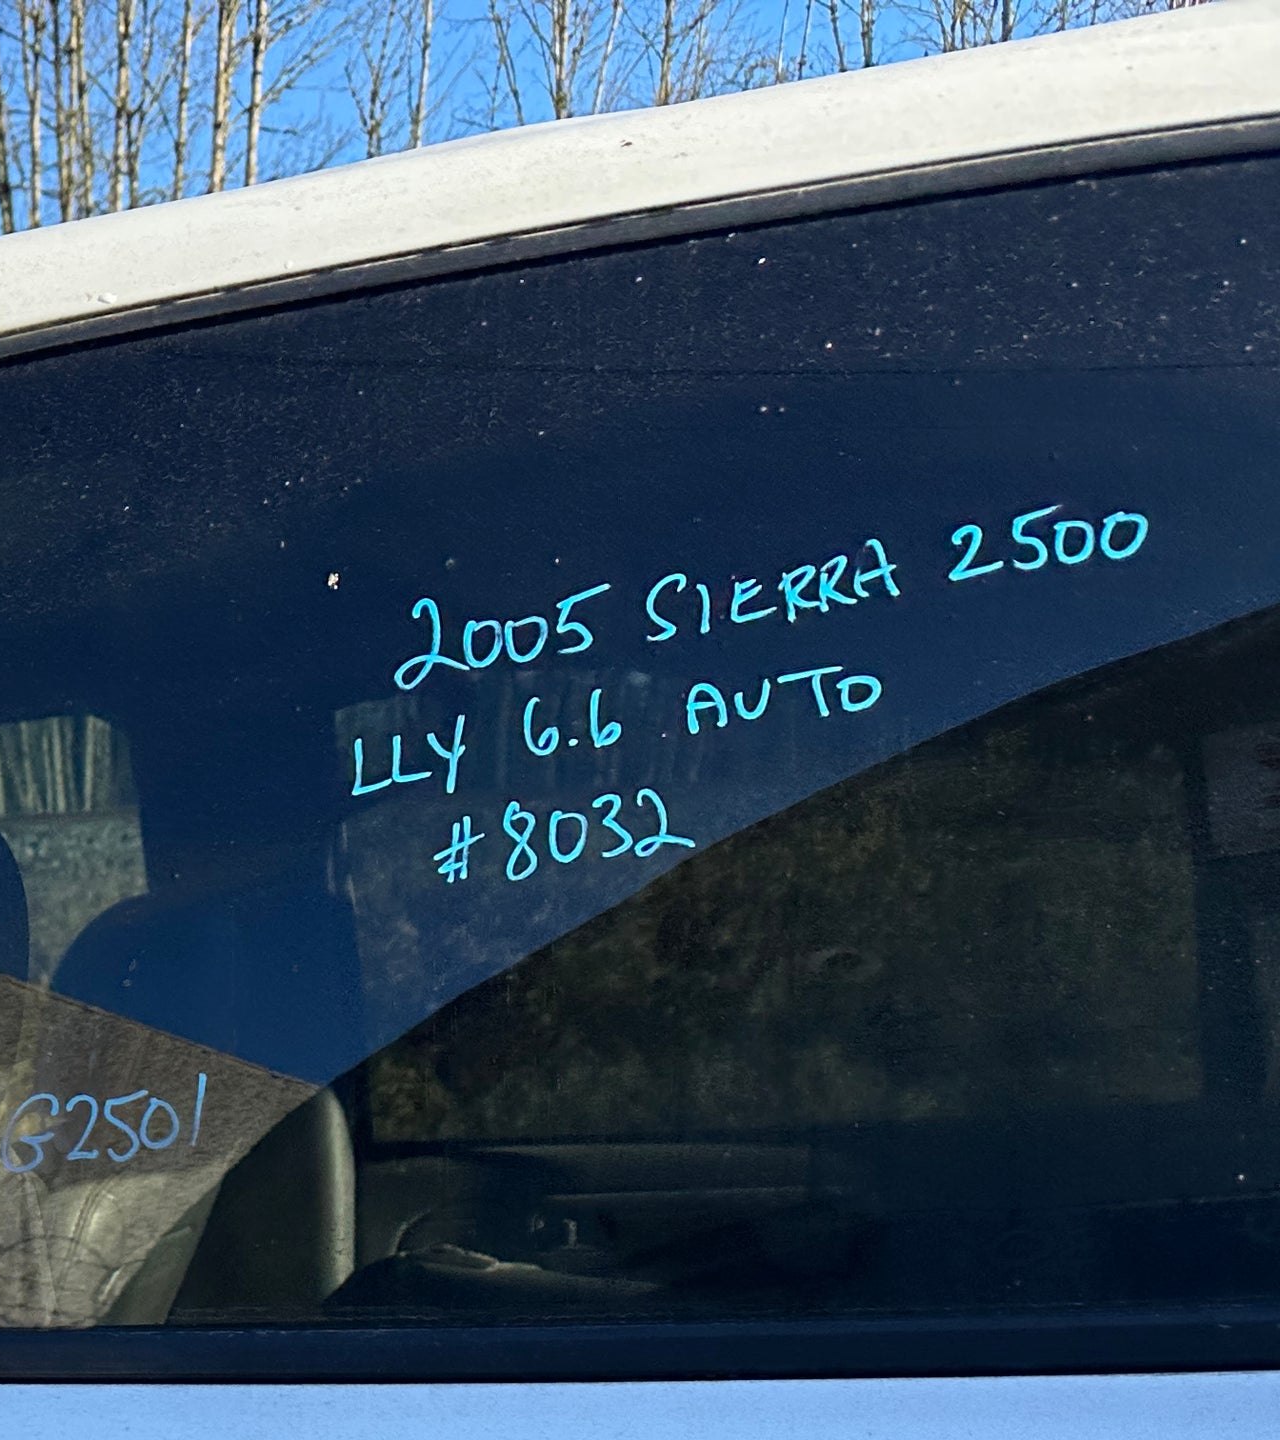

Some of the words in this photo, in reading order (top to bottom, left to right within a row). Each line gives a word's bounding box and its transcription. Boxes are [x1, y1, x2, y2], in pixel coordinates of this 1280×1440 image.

[394, 583, 611, 691] 2005
[646, 538, 902, 642] SIERRA
[947, 505, 1149, 583] 2500
[351, 714, 467, 796] LLY
[523, 689, 623, 757] 6.6
[686, 665, 883, 735] AUTO
[1, 1072, 207, 1173] G2501
